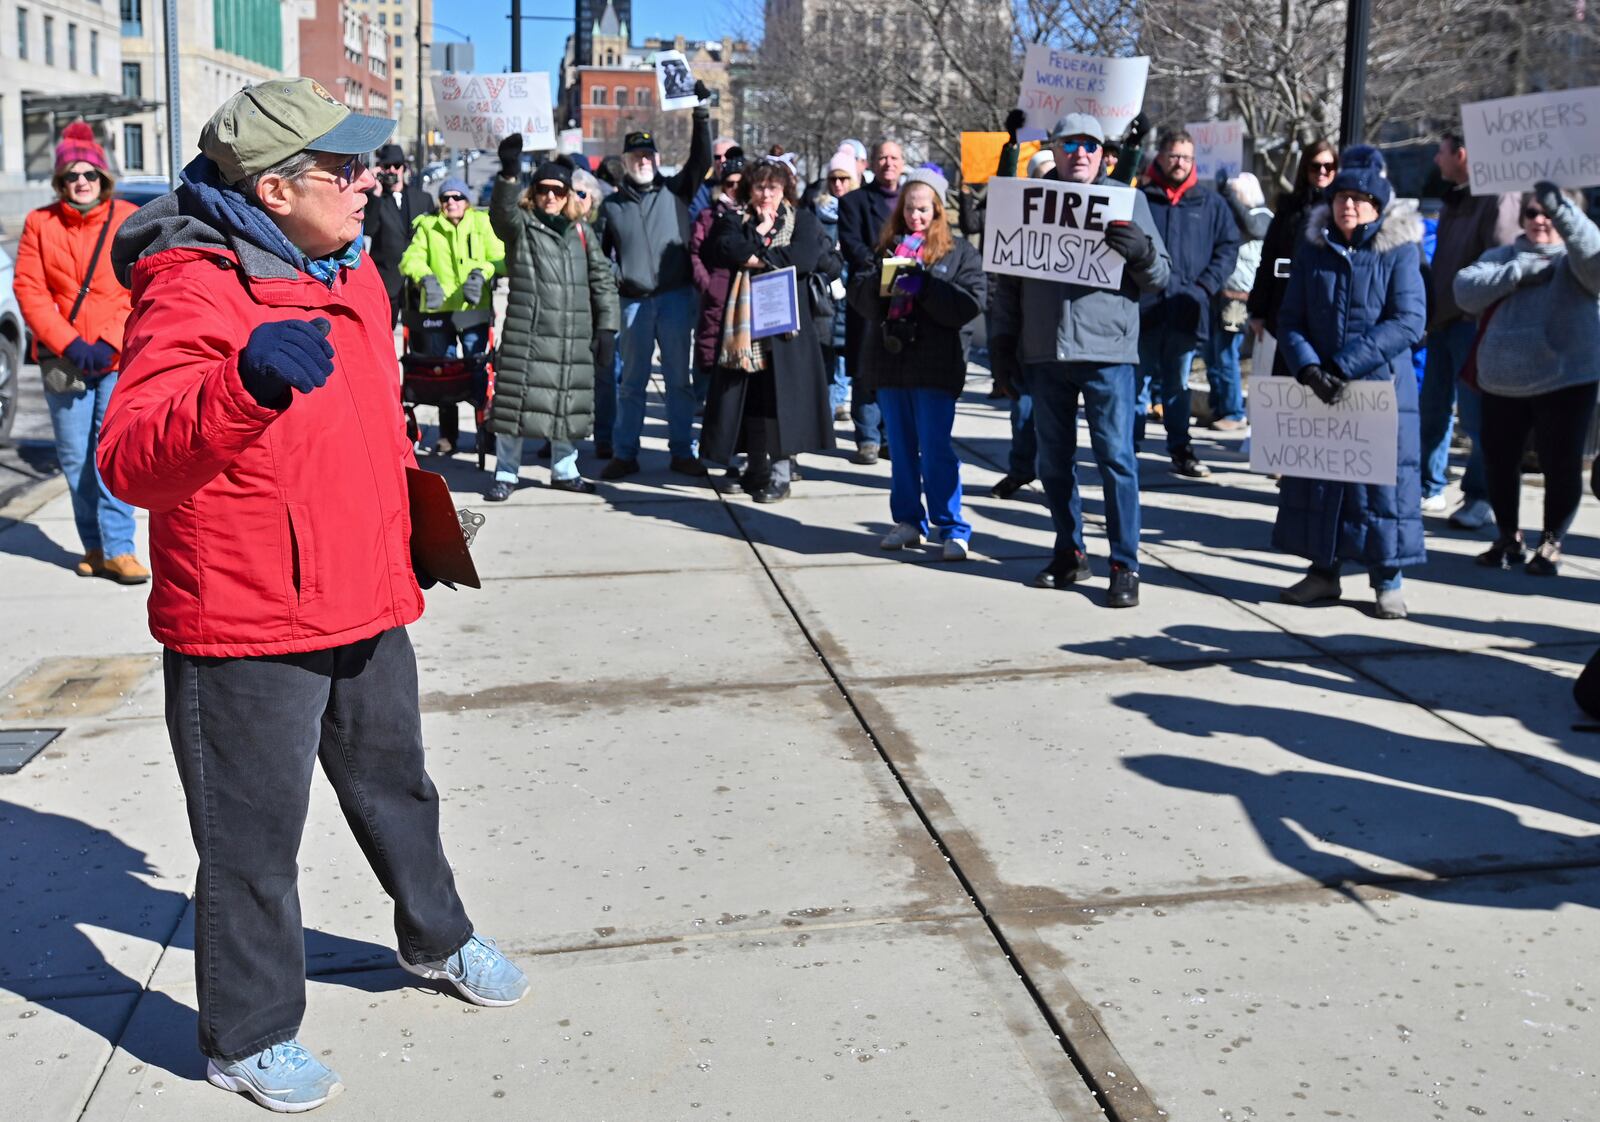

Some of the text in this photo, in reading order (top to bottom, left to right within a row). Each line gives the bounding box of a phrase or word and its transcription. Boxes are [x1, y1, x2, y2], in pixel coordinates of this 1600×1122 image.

[1048, 51, 1109, 76] FEDERAL
[441, 76, 529, 100] SAVE
[1036, 70, 1107, 92] WORKERS
[466, 100, 503, 114] OUR
[1025, 89, 1064, 114] STAY
[444, 115, 549, 134] NATIONAL
[1481, 102, 1587, 137] WORKERS
[1501, 132, 1553, 157] OVER
[1023, 187, 1110, 232] FIRE
[992, 227, 1111, 284] MUSK
[1258, 381, 1315, 410] STOP
[1276, 412, 1370, 443] FEDERAL
[1263, 445, 1372, 477] WORKERS
